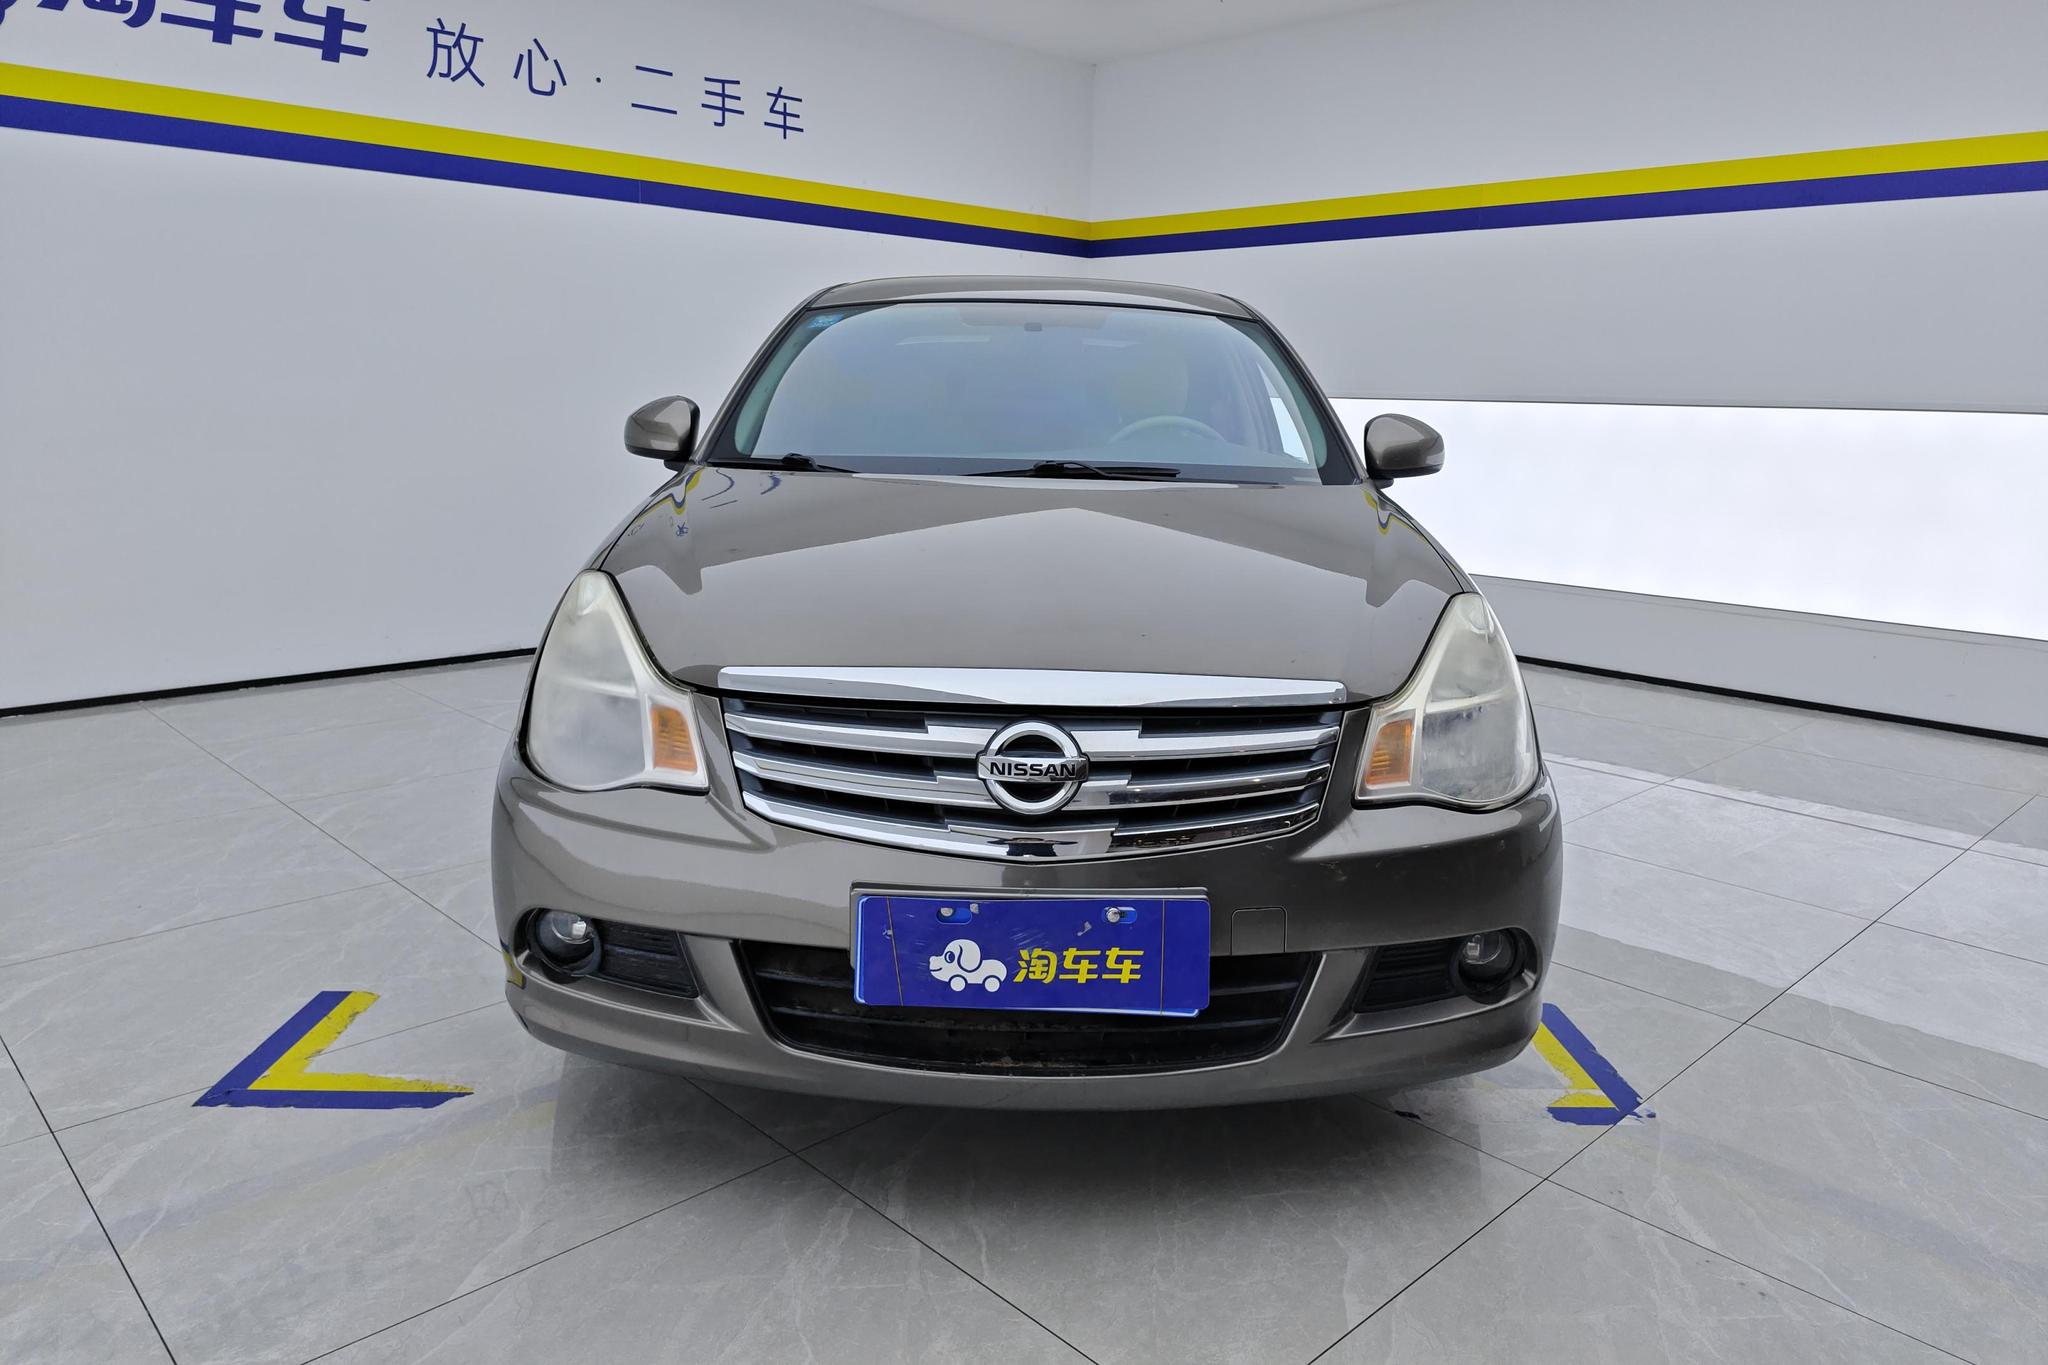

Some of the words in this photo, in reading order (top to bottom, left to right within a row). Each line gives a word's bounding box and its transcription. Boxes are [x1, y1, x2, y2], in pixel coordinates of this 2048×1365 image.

[990, 762, 1076, 777] NISSAN
[1013, 948, 1144, 984] 淘车车
